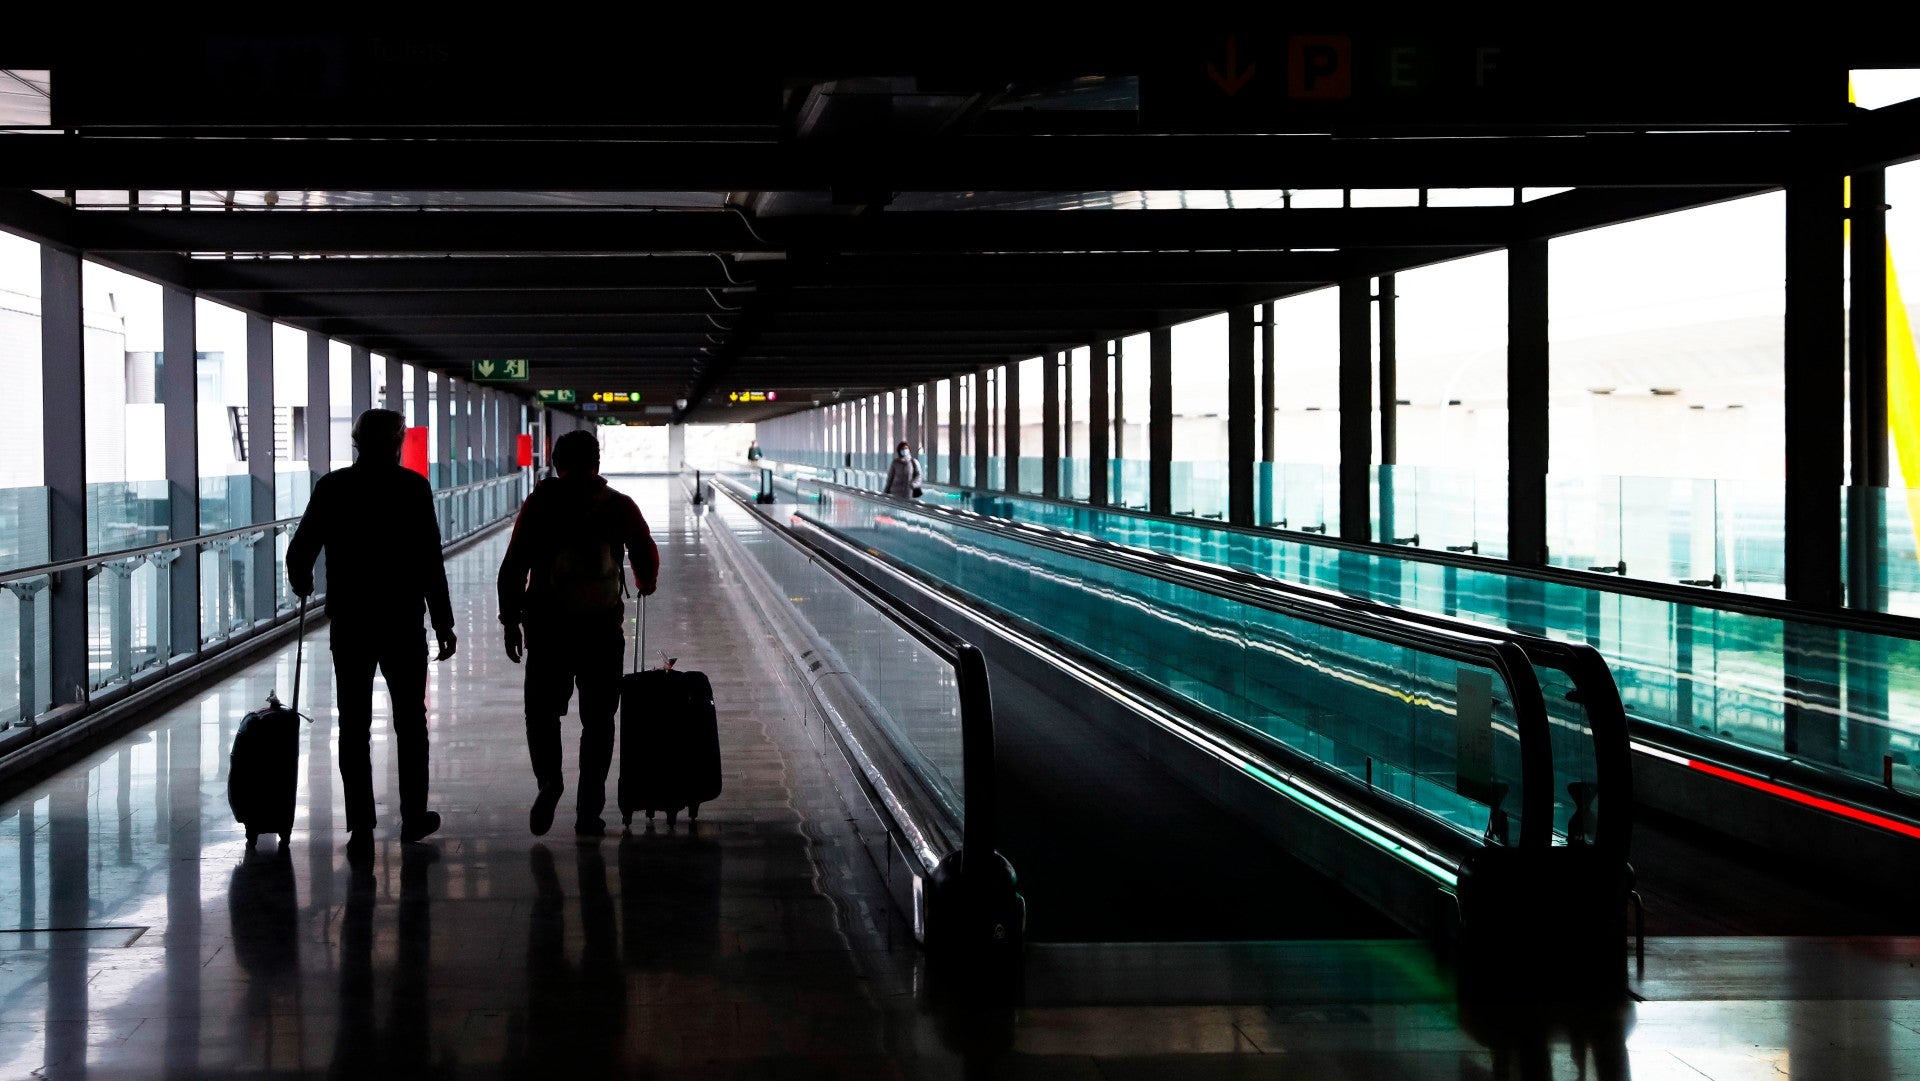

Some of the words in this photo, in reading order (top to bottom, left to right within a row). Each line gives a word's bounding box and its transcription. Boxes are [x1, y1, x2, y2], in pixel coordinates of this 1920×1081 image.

[368, 37, 449, 64] Tolets
[1302, 43, 1338, 92] P
[1391, 46, 1417, 87] E
[1476, 46, 1501, 87] F
